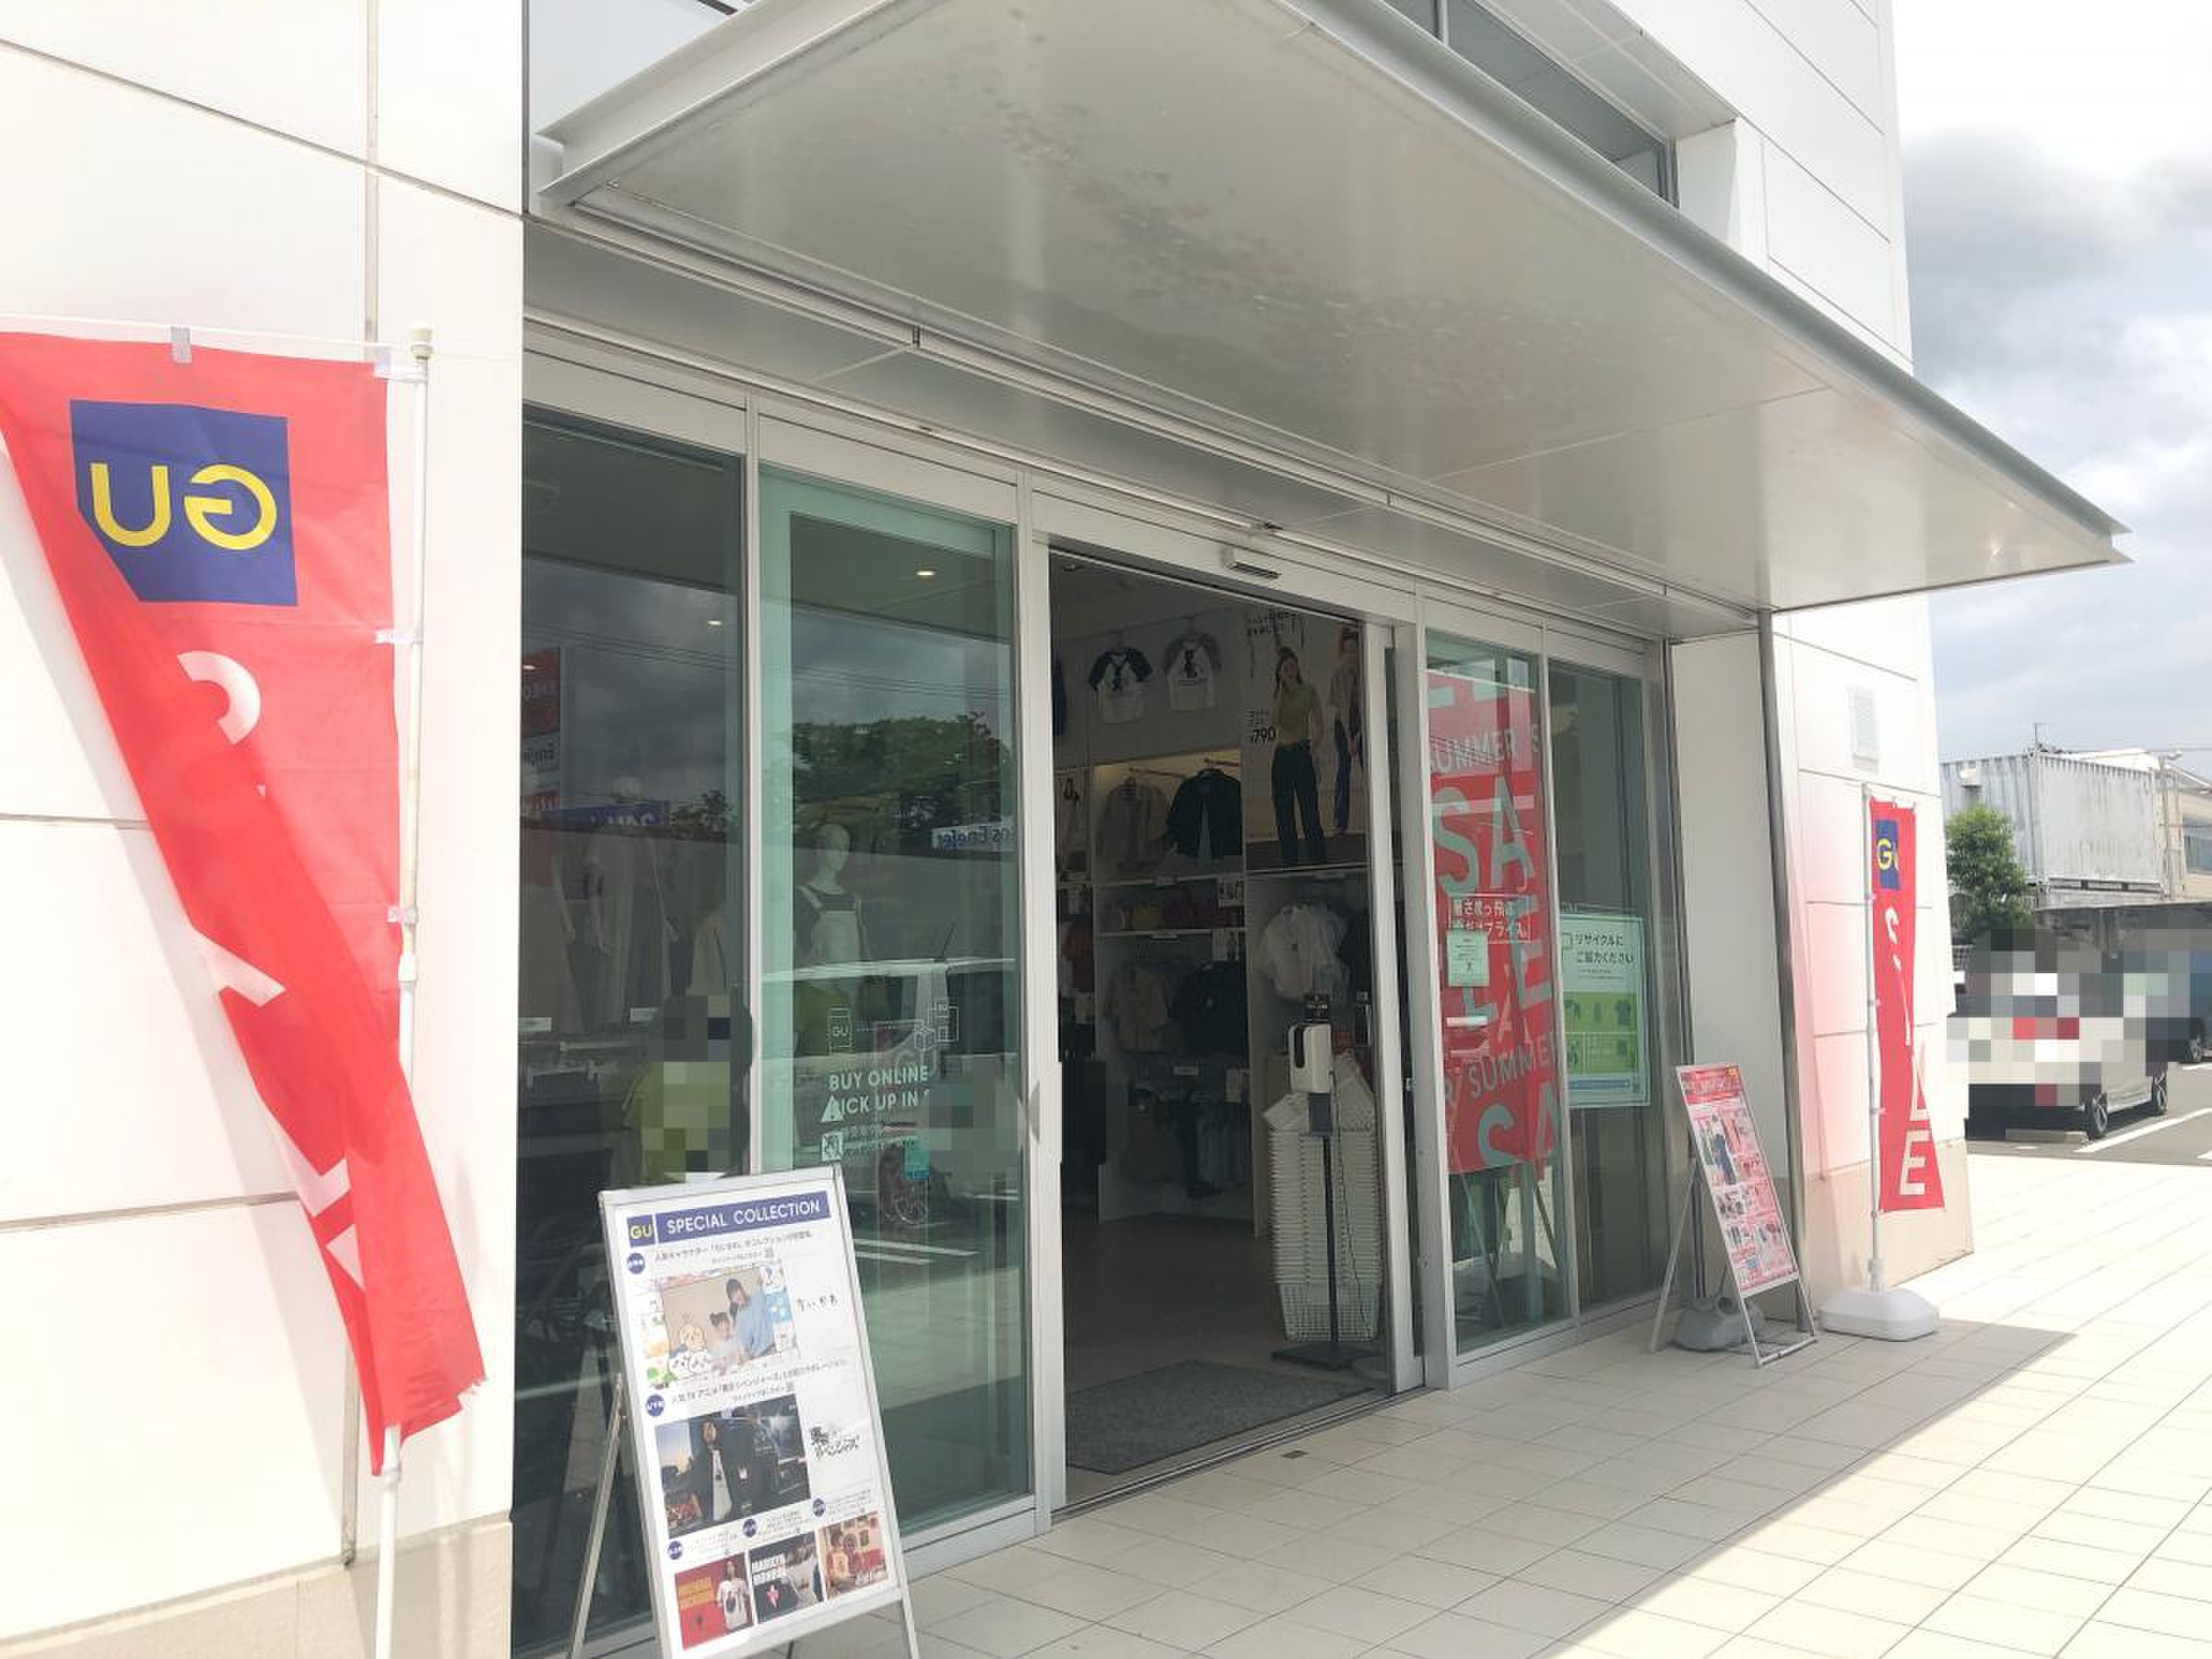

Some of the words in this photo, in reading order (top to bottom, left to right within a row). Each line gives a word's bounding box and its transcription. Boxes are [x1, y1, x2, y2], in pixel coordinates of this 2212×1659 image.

[830, 1071, 863, 1092] BUY
[867, 1065, 929, 1088] ONLINE
[830, 1095, 871, 1116] ICK
[876, 1091, 897, 1112] UP
[901, 1089, 919, 1108] IN
[666, 1213, 728, 1235] SPECIAL
[733, 1199, 822, 1225] COLLECTION
[629, 1222, 653, 1241] GU
